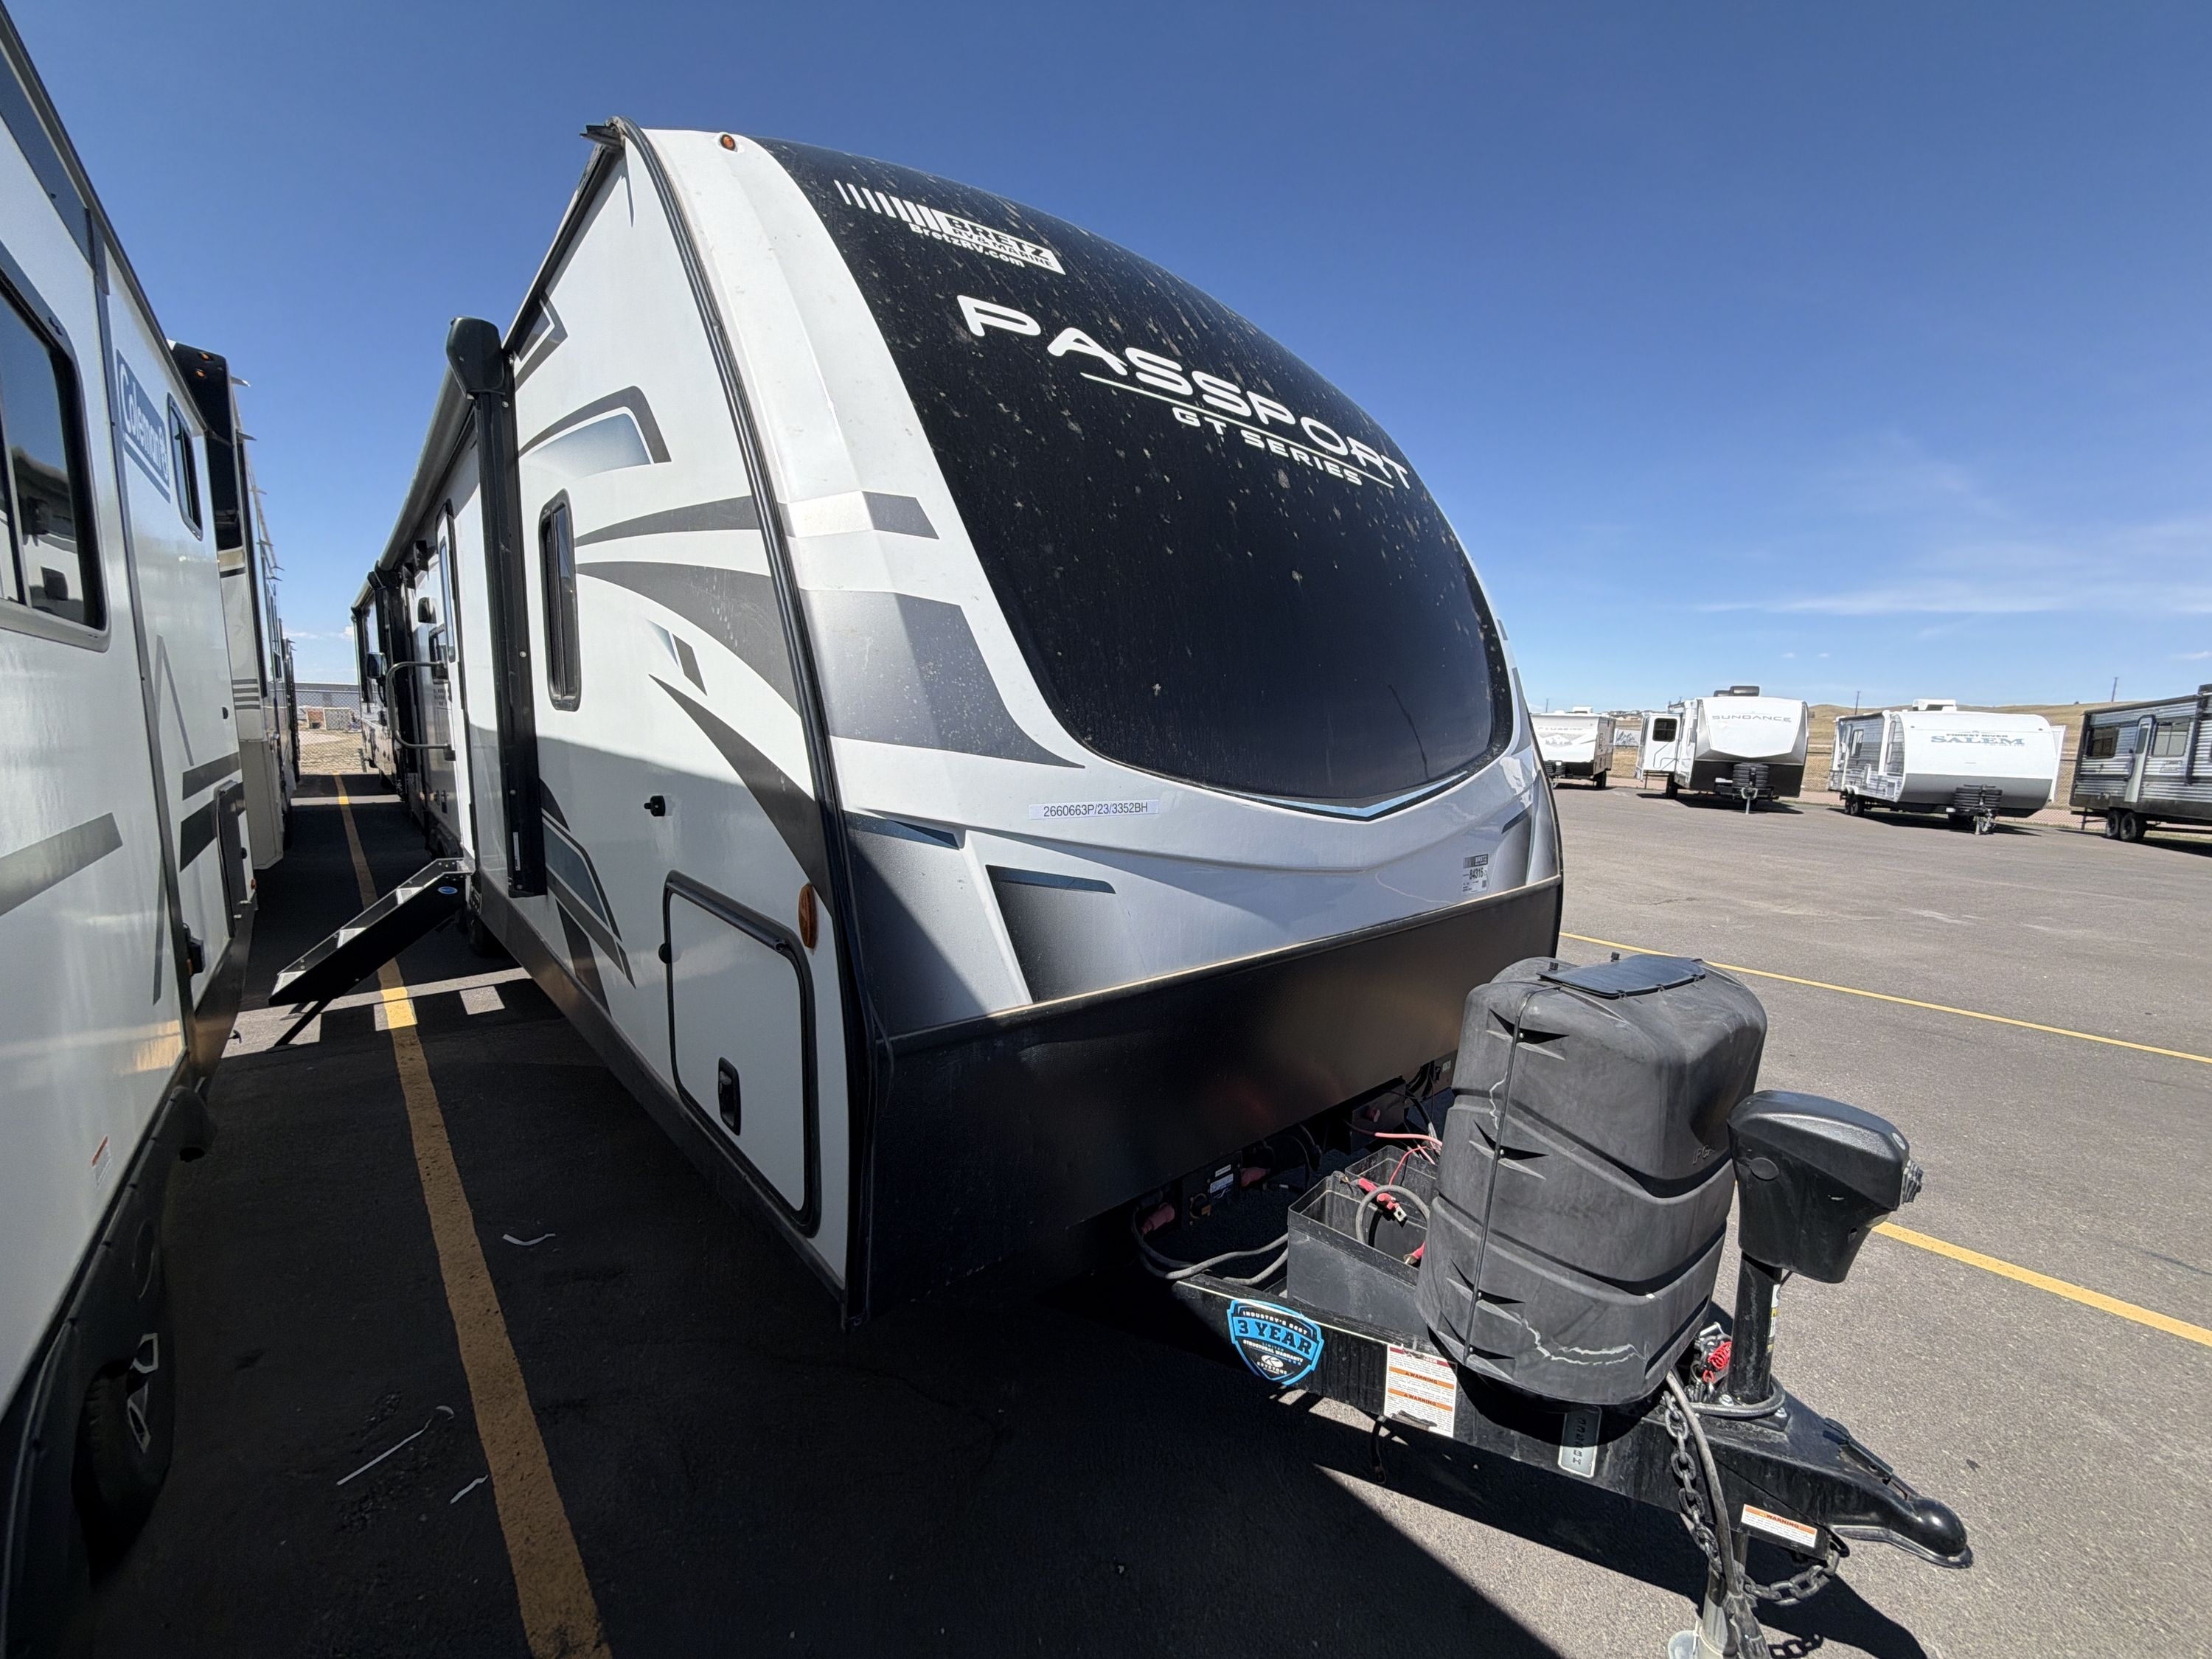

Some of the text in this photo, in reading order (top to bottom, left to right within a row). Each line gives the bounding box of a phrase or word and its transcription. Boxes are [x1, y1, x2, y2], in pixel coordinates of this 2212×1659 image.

[908, 222, 1026, 268] BretzRV.com
[944, 215, 1049, 260] BRETZ
[957, 295, 1411, 489] PASSPORT
[119, 364, 164, 472] Coleman
[1172, 407, 1363, 486] GT SERIES
[1712, 714, 1792, 723] SUNDANCE
[1930, 735, 2025, 745] SALEM
[1043, 802, 1148, 818] 2660663P/23/3352BH
[1242, 1311, 1308, 1335] INDUSTRY'S BEST
[1237, 1319, 1312, 1355] 3 YEAR
[1242, 1339, 1304, 1363] STRUCTURAL WARRANTY
[1256, 1361, 1287, 1375] KEYSTONE
[1411, 1372, 1438, 1385] WARNING
[1409, 1394, 1437, 1406] WARNING
[1766, 1514, 1799, 1528] WARNING
